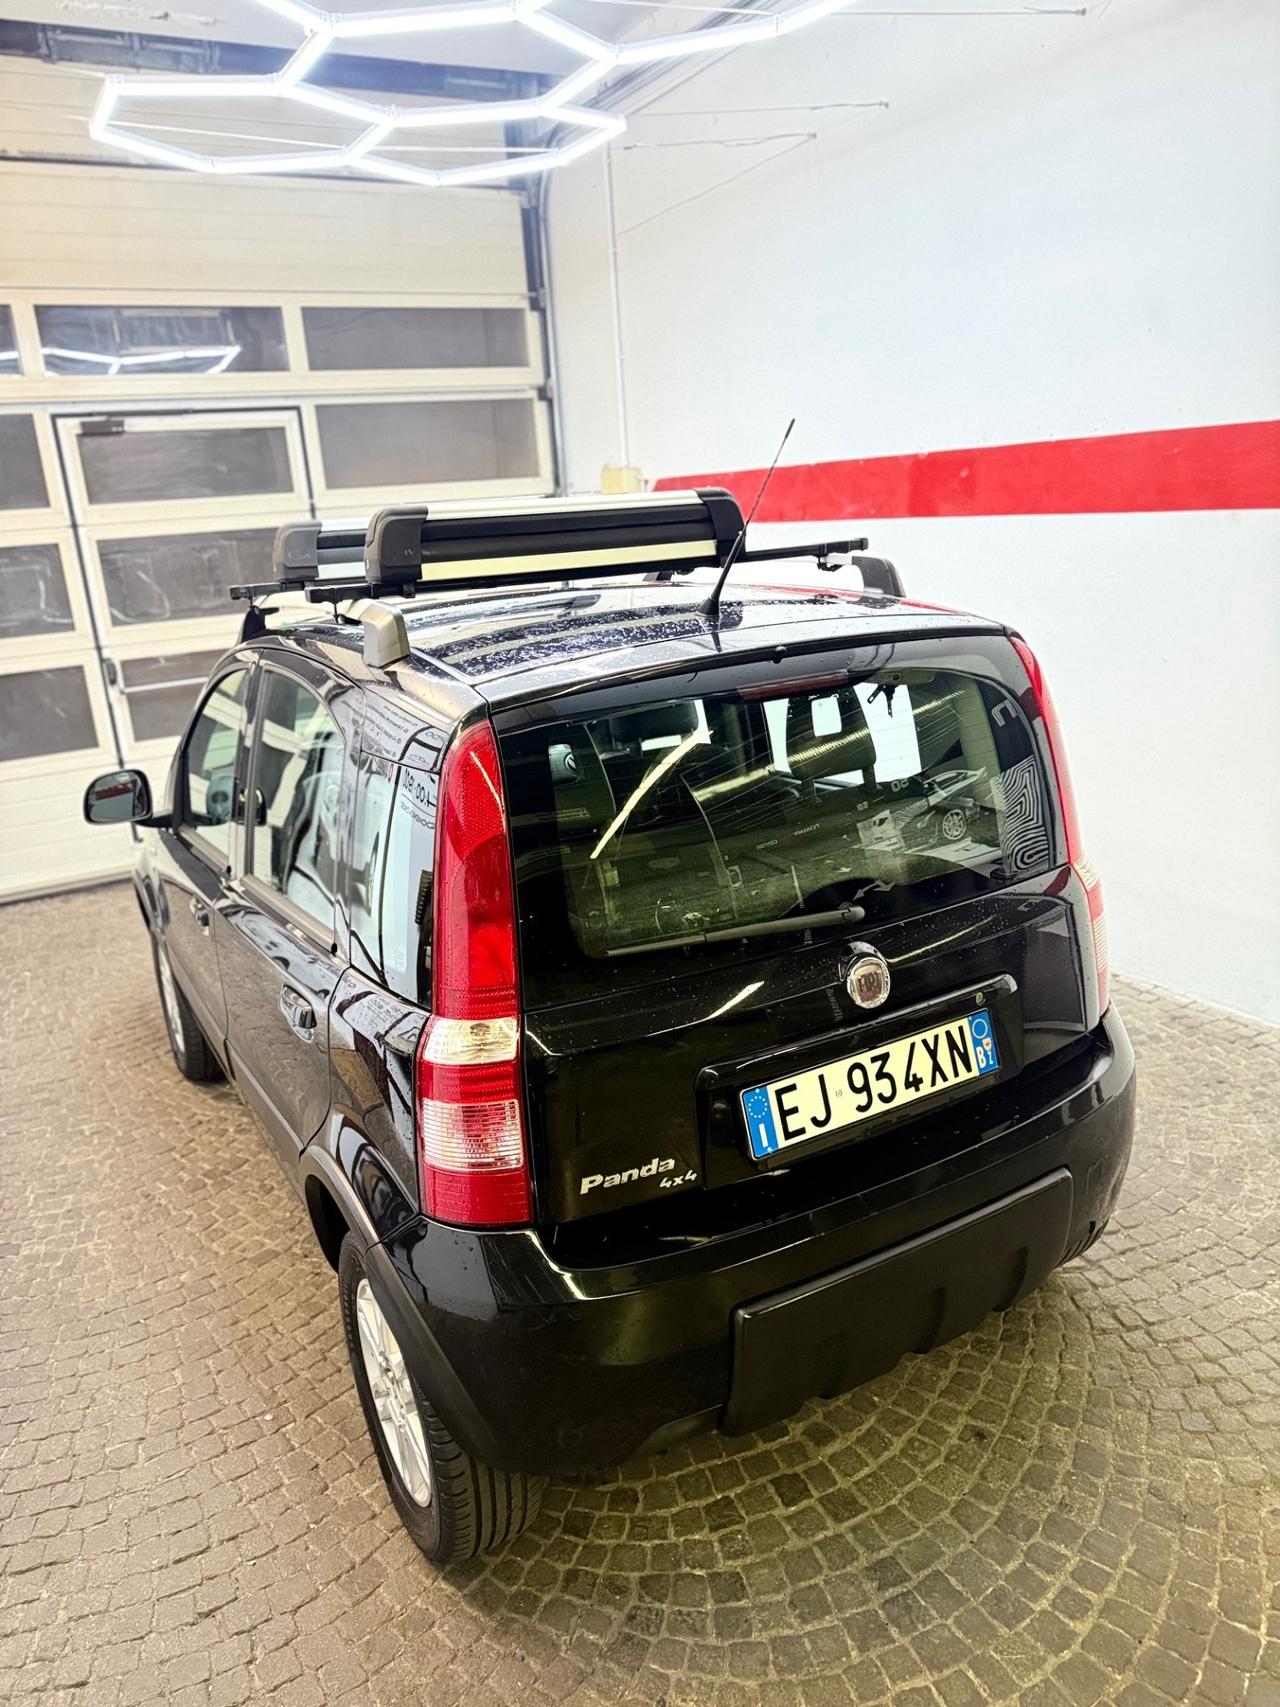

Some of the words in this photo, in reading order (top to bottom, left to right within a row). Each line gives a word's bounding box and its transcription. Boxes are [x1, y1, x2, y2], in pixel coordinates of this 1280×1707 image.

[774, 1073, 832, 1141] EJ
[847, 1025, 973, 1113] 934XN
[580, 1157, 676, 1195] Panda
[659, 1169, 697, 1188] 4x4
